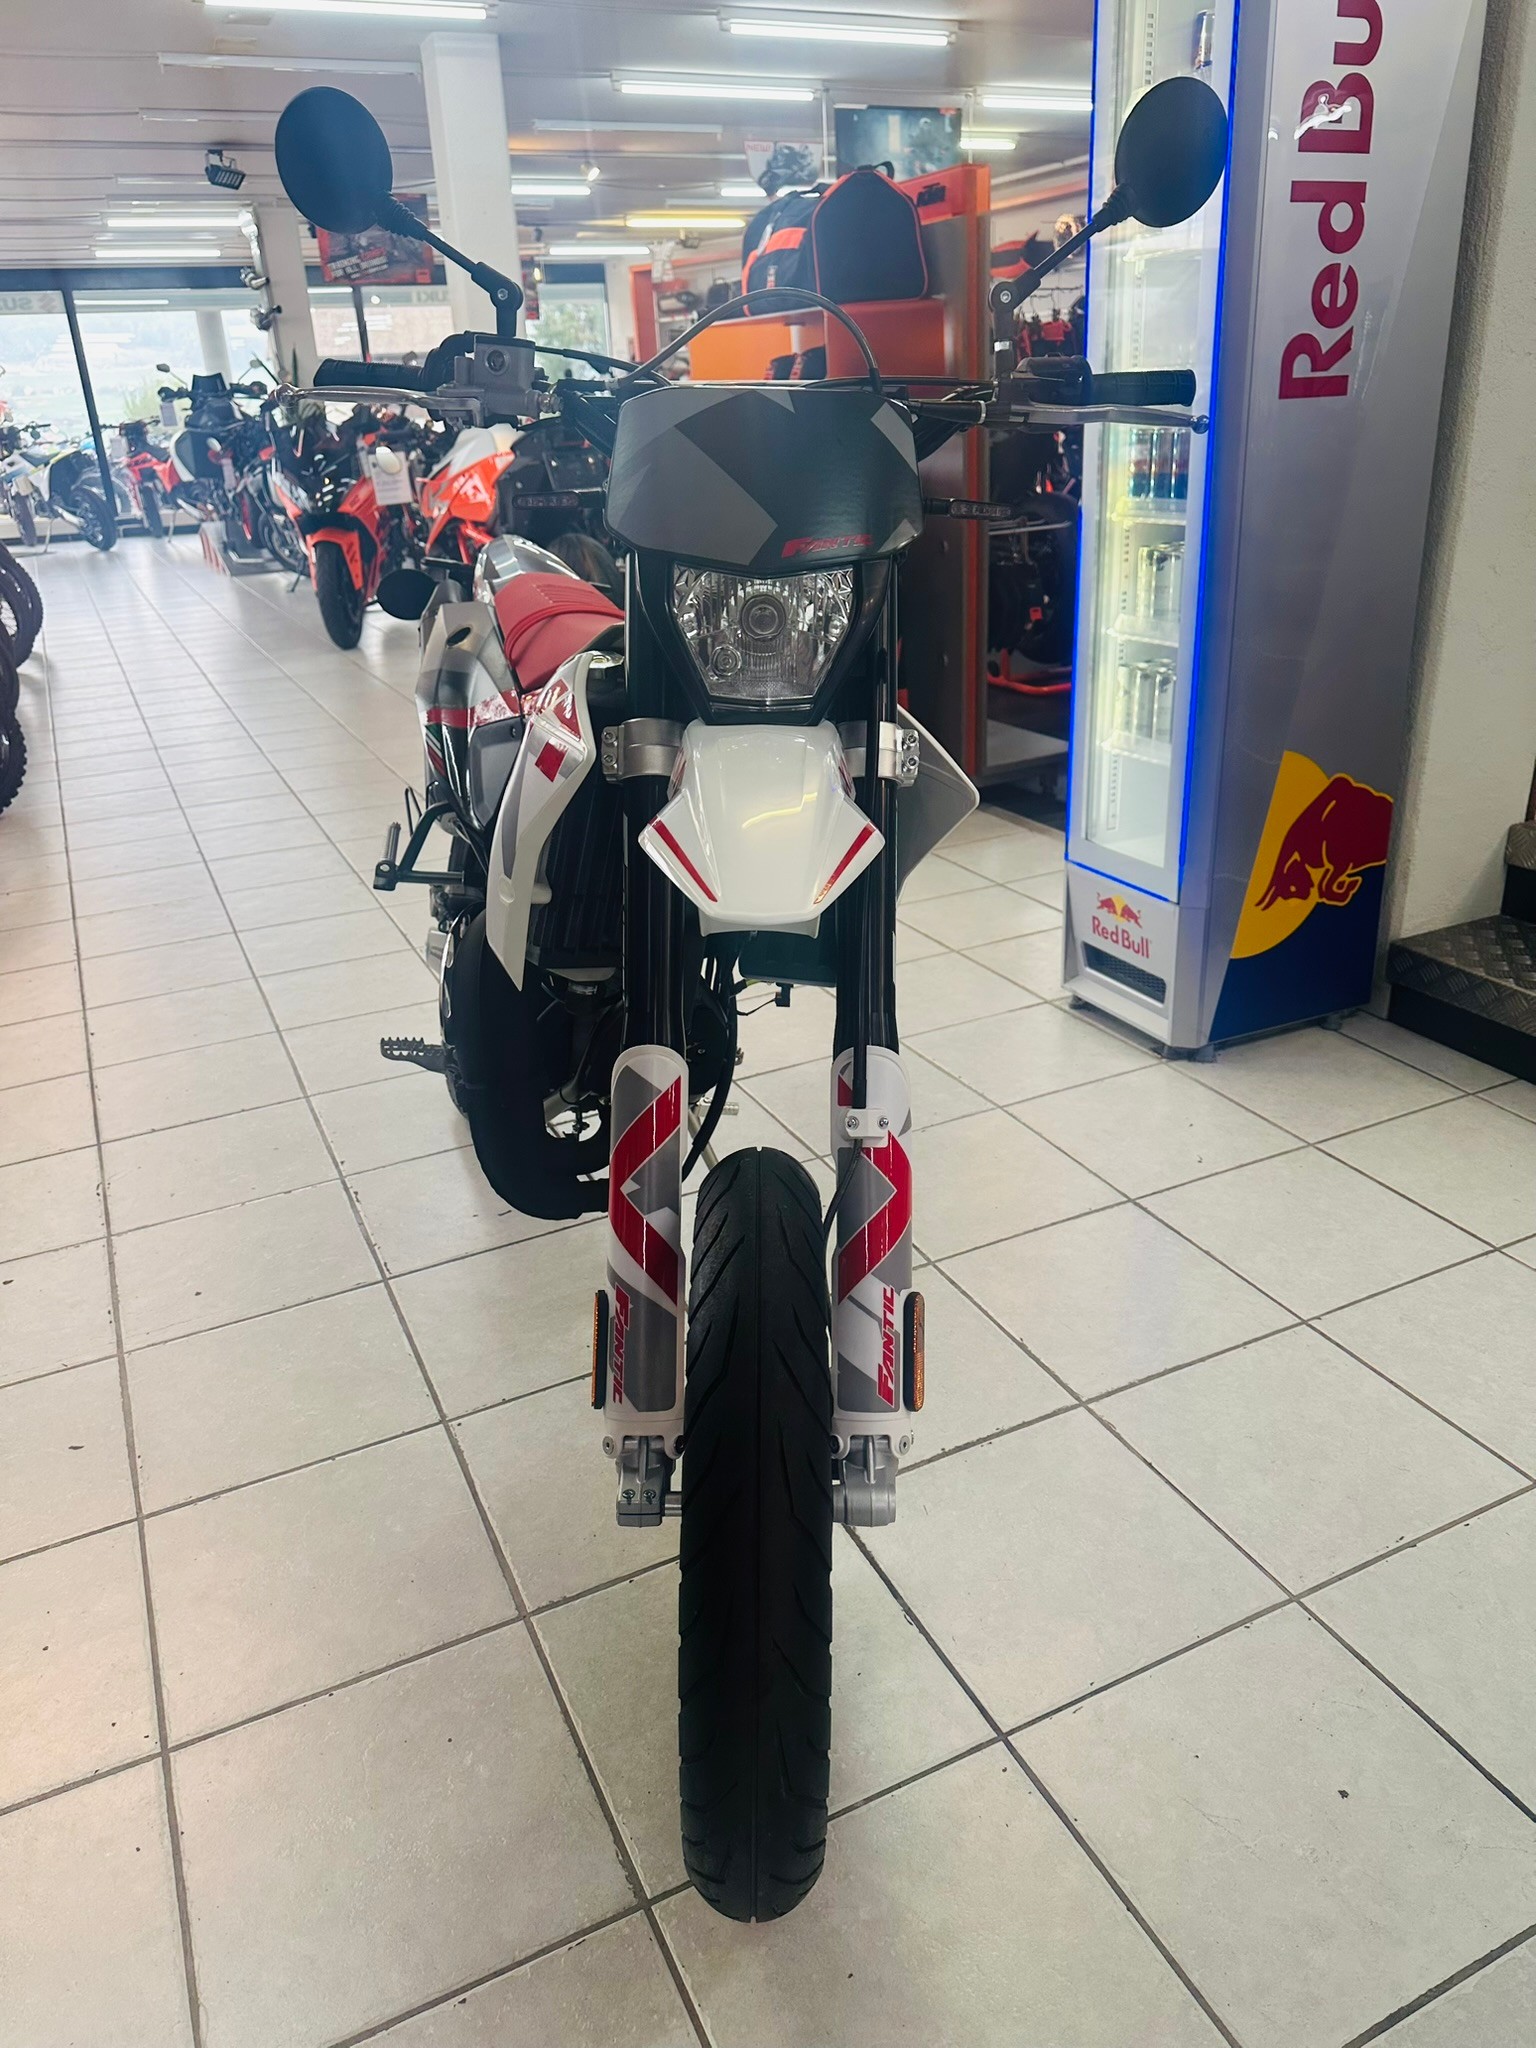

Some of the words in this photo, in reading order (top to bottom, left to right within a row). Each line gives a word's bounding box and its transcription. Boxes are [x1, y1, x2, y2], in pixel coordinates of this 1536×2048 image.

[1278, 180, 1367, 400] Red
[1092, 915, 1119, 945] Red
[1121, 928, 1149, 958] Bull
[614, 1282, 630, 1405] FANTIC
[877, 1285, 894, 1409] FANTIC
